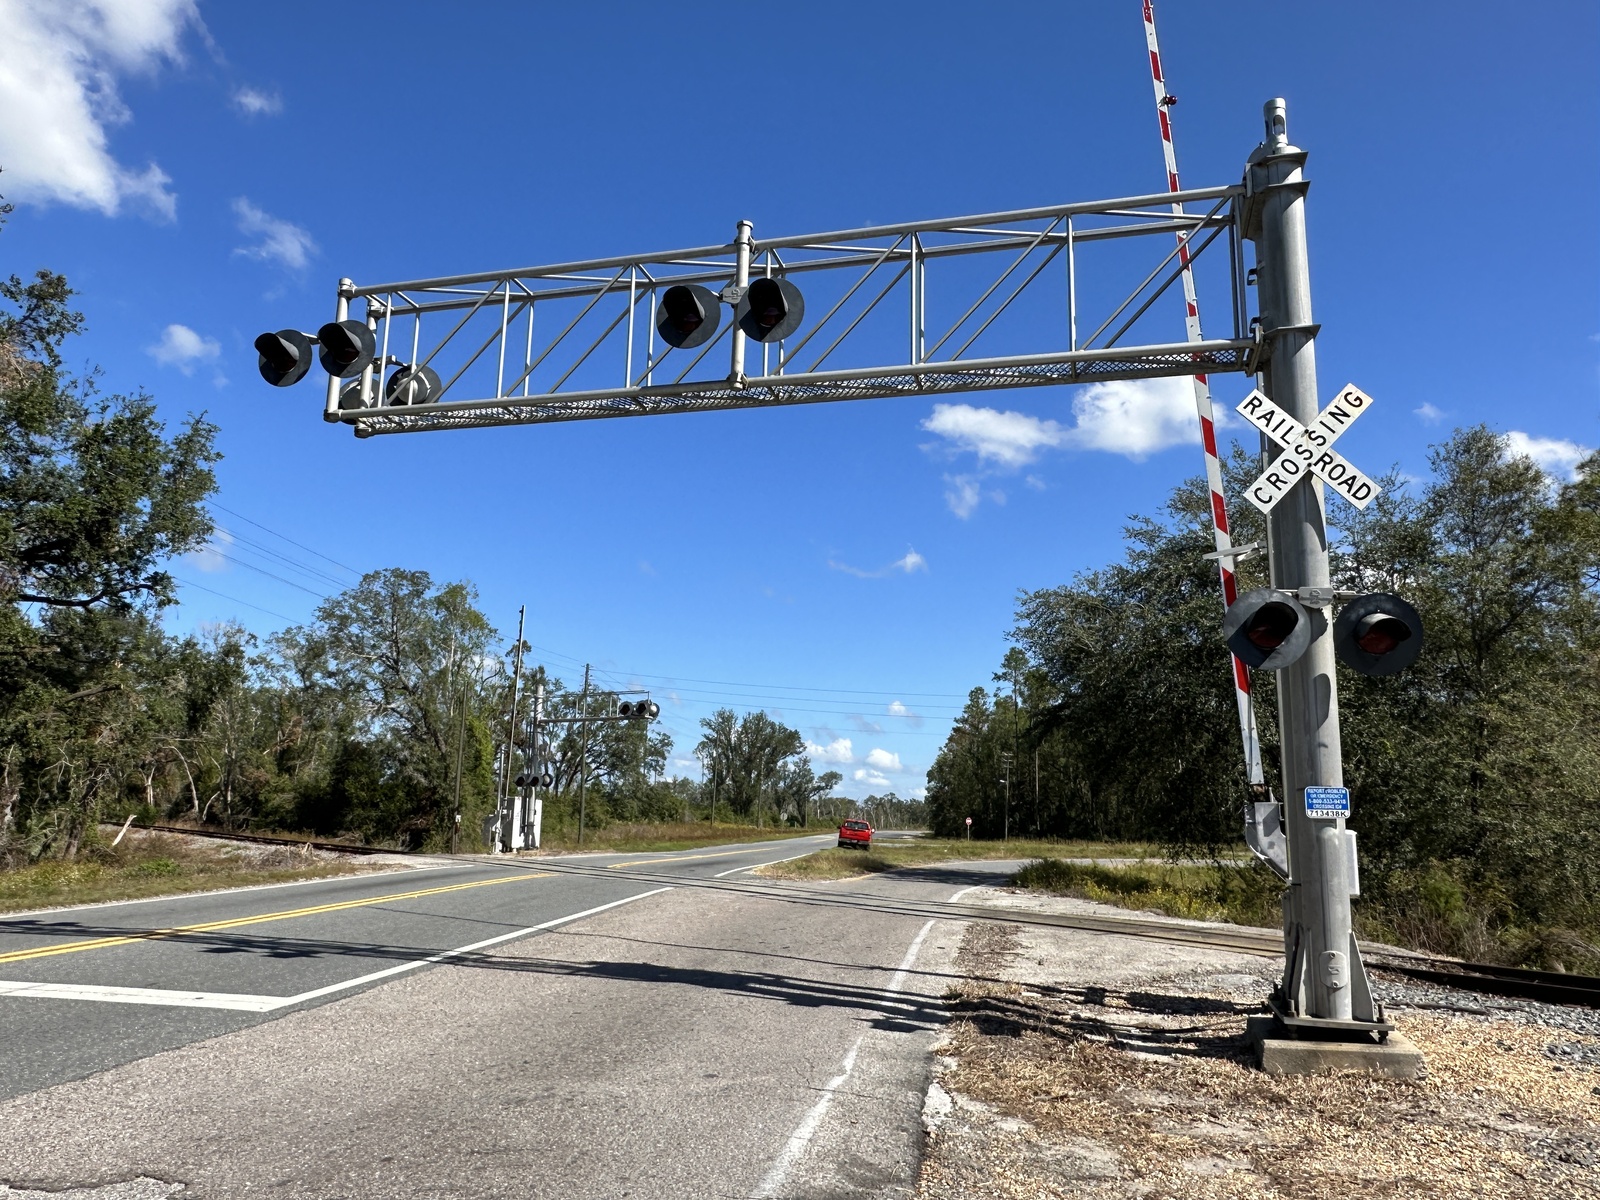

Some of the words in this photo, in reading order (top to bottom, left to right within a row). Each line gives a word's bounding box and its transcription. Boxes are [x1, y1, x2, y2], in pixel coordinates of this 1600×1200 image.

[1243, 396, 1294, 445] RAIL
[1313, 452, 1371, 501] ROAD
[1253, 391, 1363, 505] CROSSING
